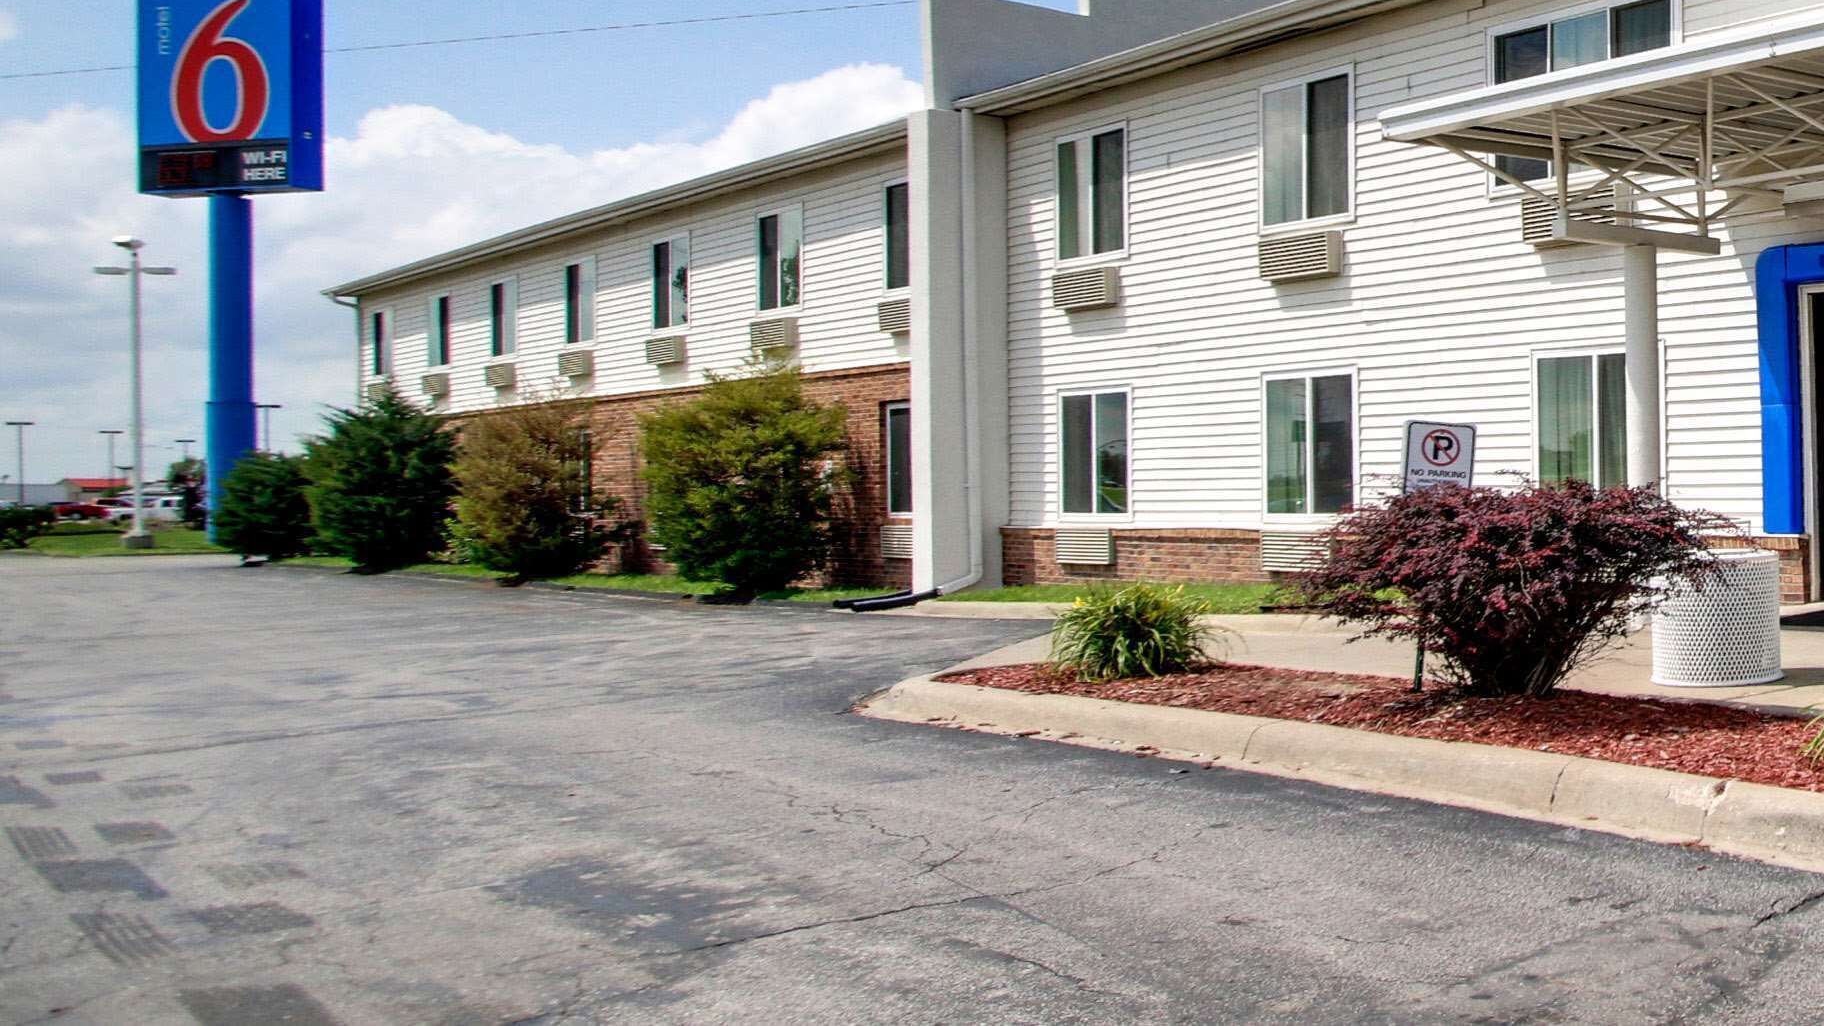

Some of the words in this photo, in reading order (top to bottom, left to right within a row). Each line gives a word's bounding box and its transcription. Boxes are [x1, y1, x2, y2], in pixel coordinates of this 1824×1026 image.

[156, 6, 170, 55] motel
[242, 150, 287, 165] WI-FI
[243, 166, 286, 182] HERE
[1410, 468, 1425, 477] NO
[1427, 469, 1467, 479] PARKING
